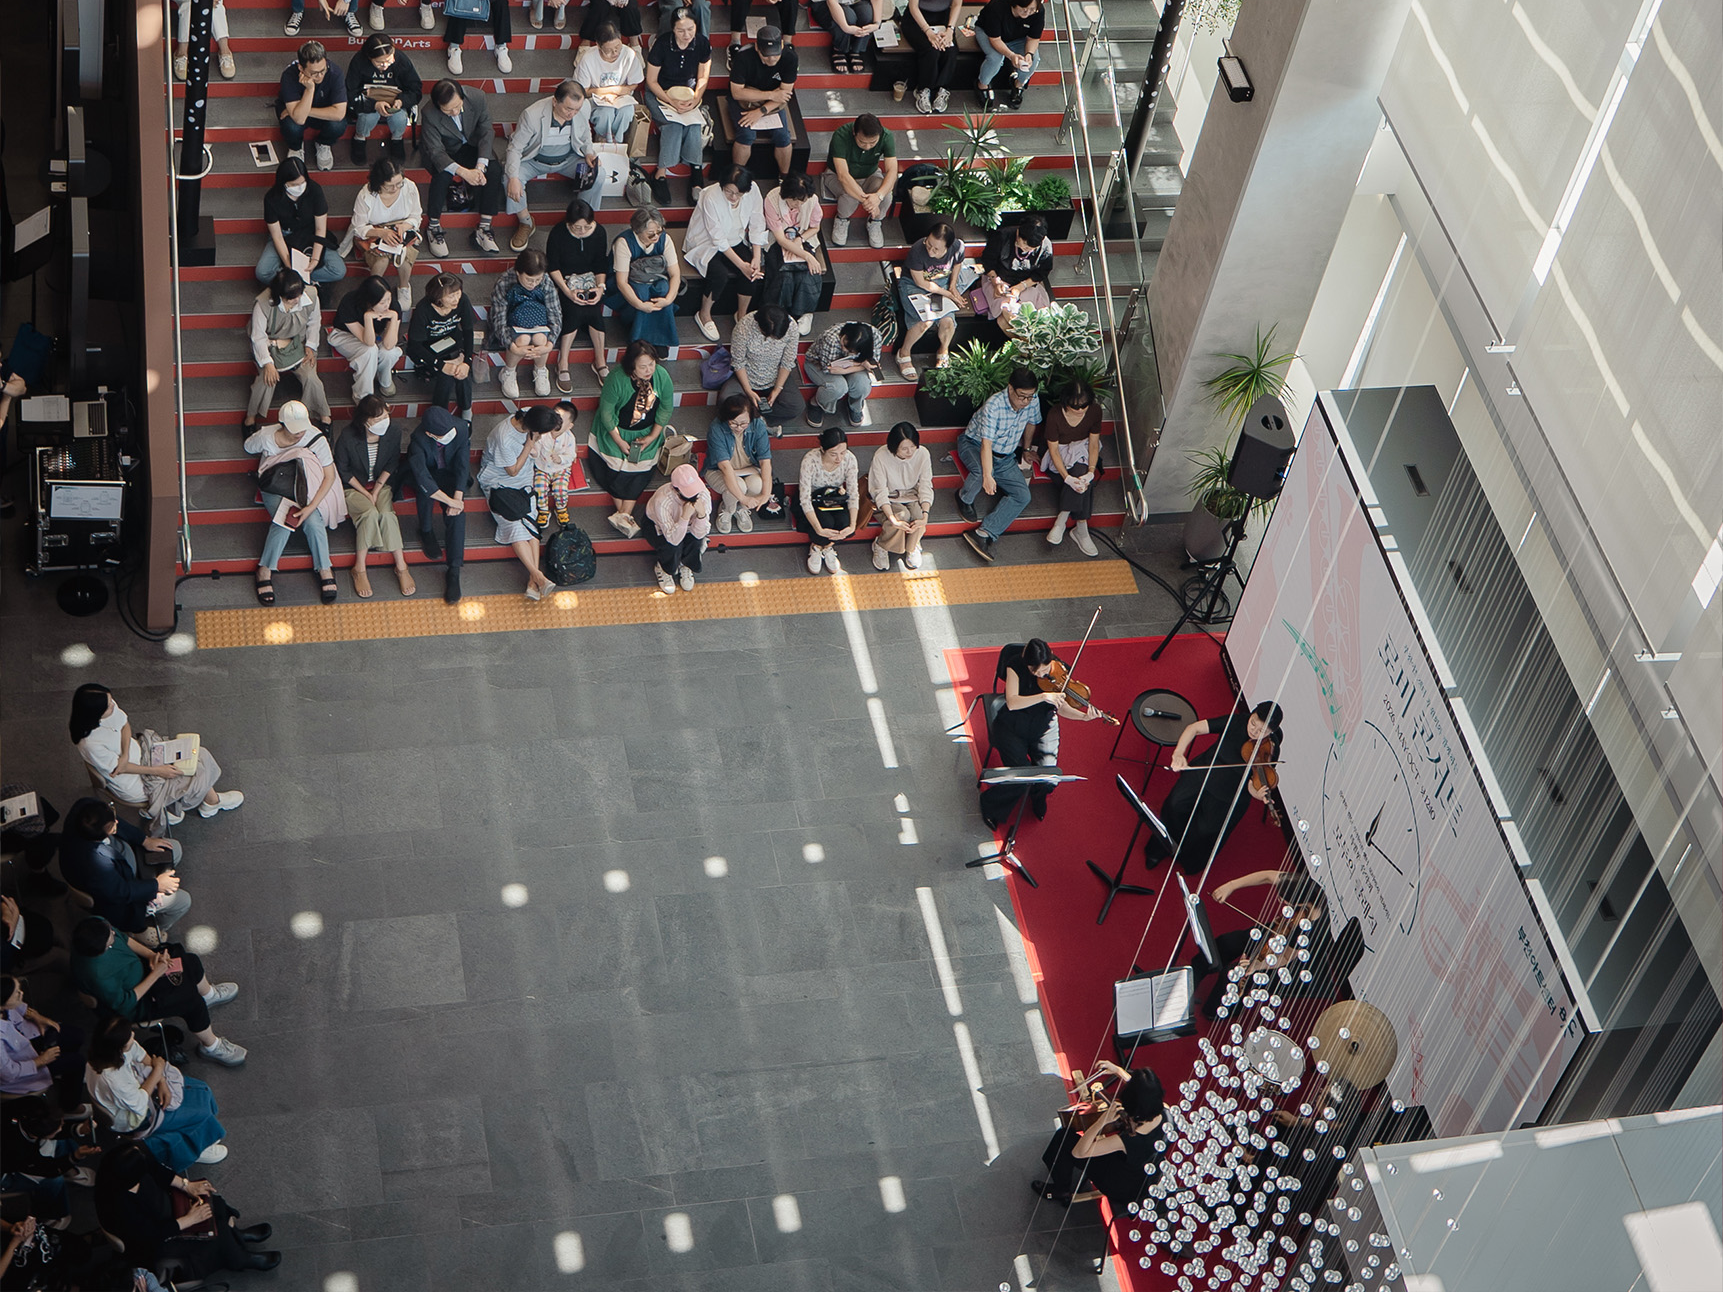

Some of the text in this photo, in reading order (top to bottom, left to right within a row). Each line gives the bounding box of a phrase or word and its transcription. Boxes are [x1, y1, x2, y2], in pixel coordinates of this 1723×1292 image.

[403, 39, 431, 48] Arts
[1377, 633, 1464, 838] 로비 콘서트
[1517, 925, 1557, 1016] 부천아트센터
